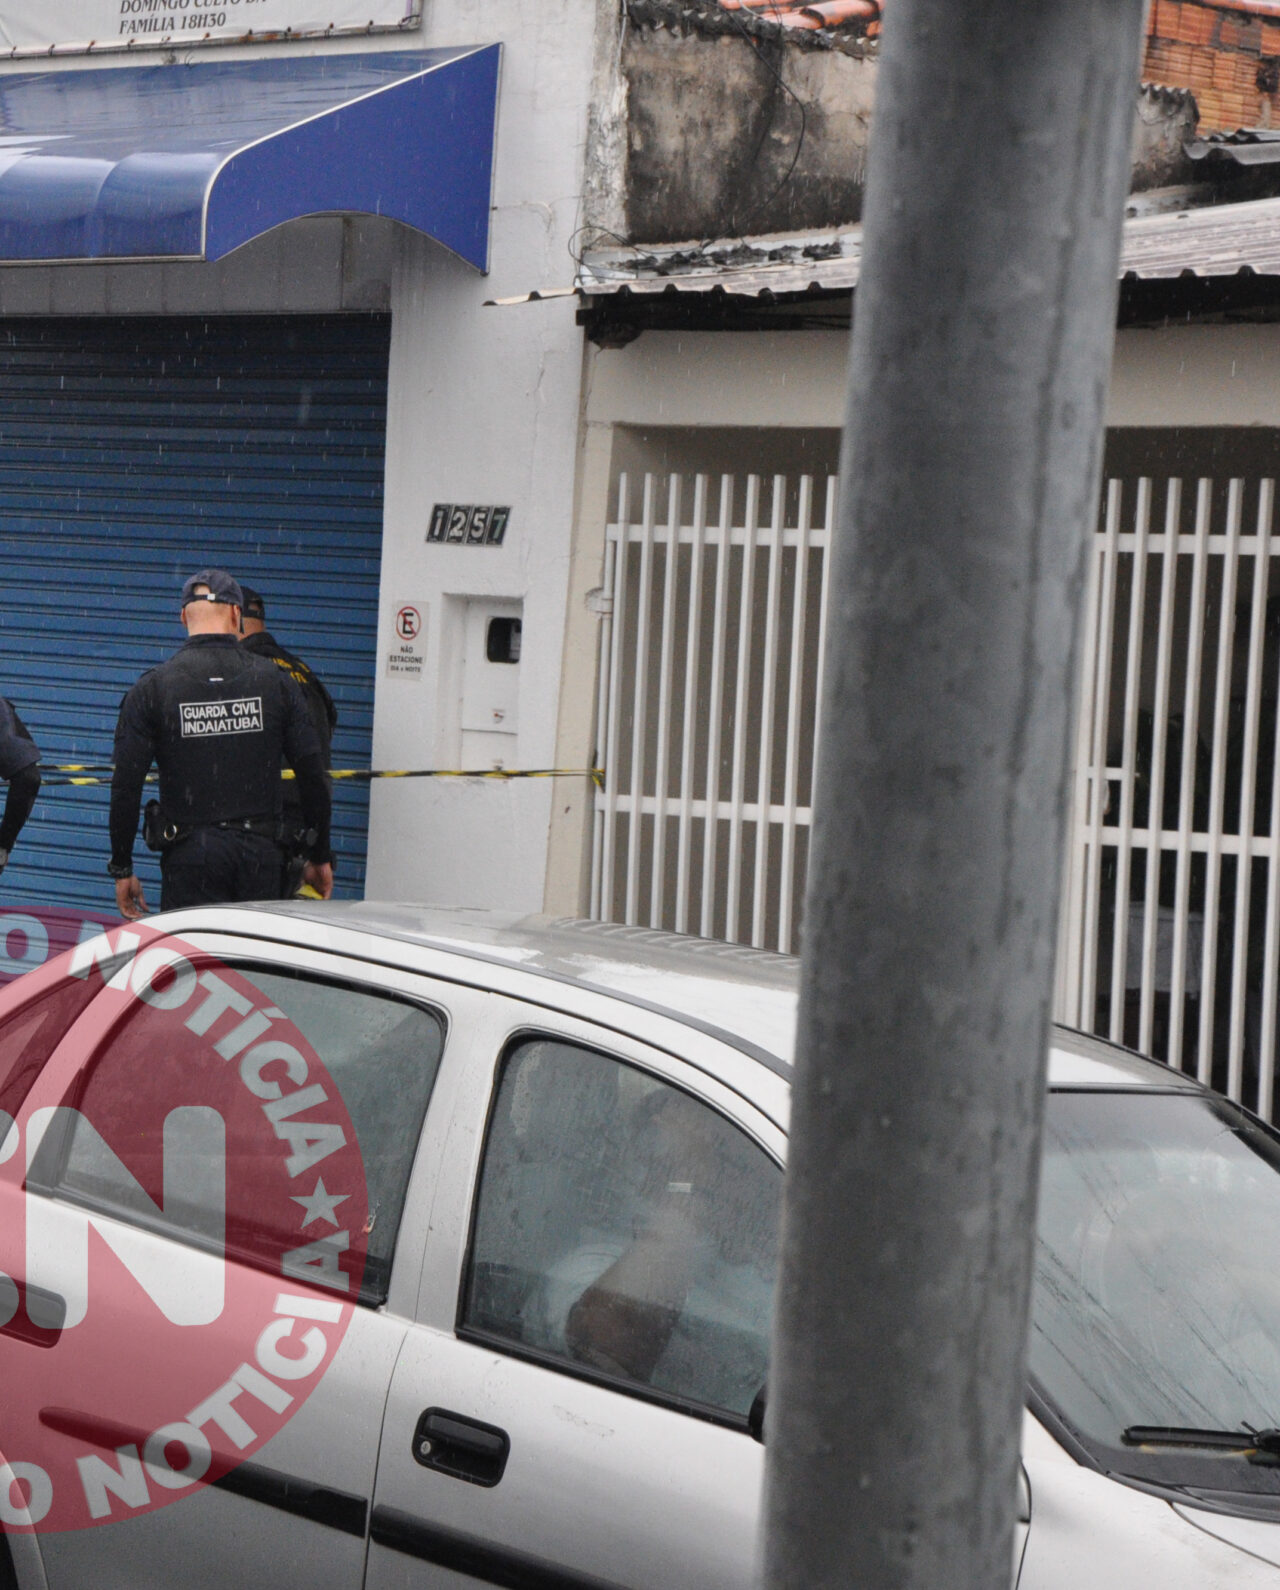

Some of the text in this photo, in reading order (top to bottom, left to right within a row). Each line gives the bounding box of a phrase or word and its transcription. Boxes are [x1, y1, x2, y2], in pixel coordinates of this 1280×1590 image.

[119, 12, 226, 34] FAMÍLIA 18H30
[433, 511, 506, 539] 1257
[389, 654, 423, 665] ESTACIONE
[183, 701, 259, 719] GUARDA CIVIL
[184, 716, 260, 734] INDAIATUBA
